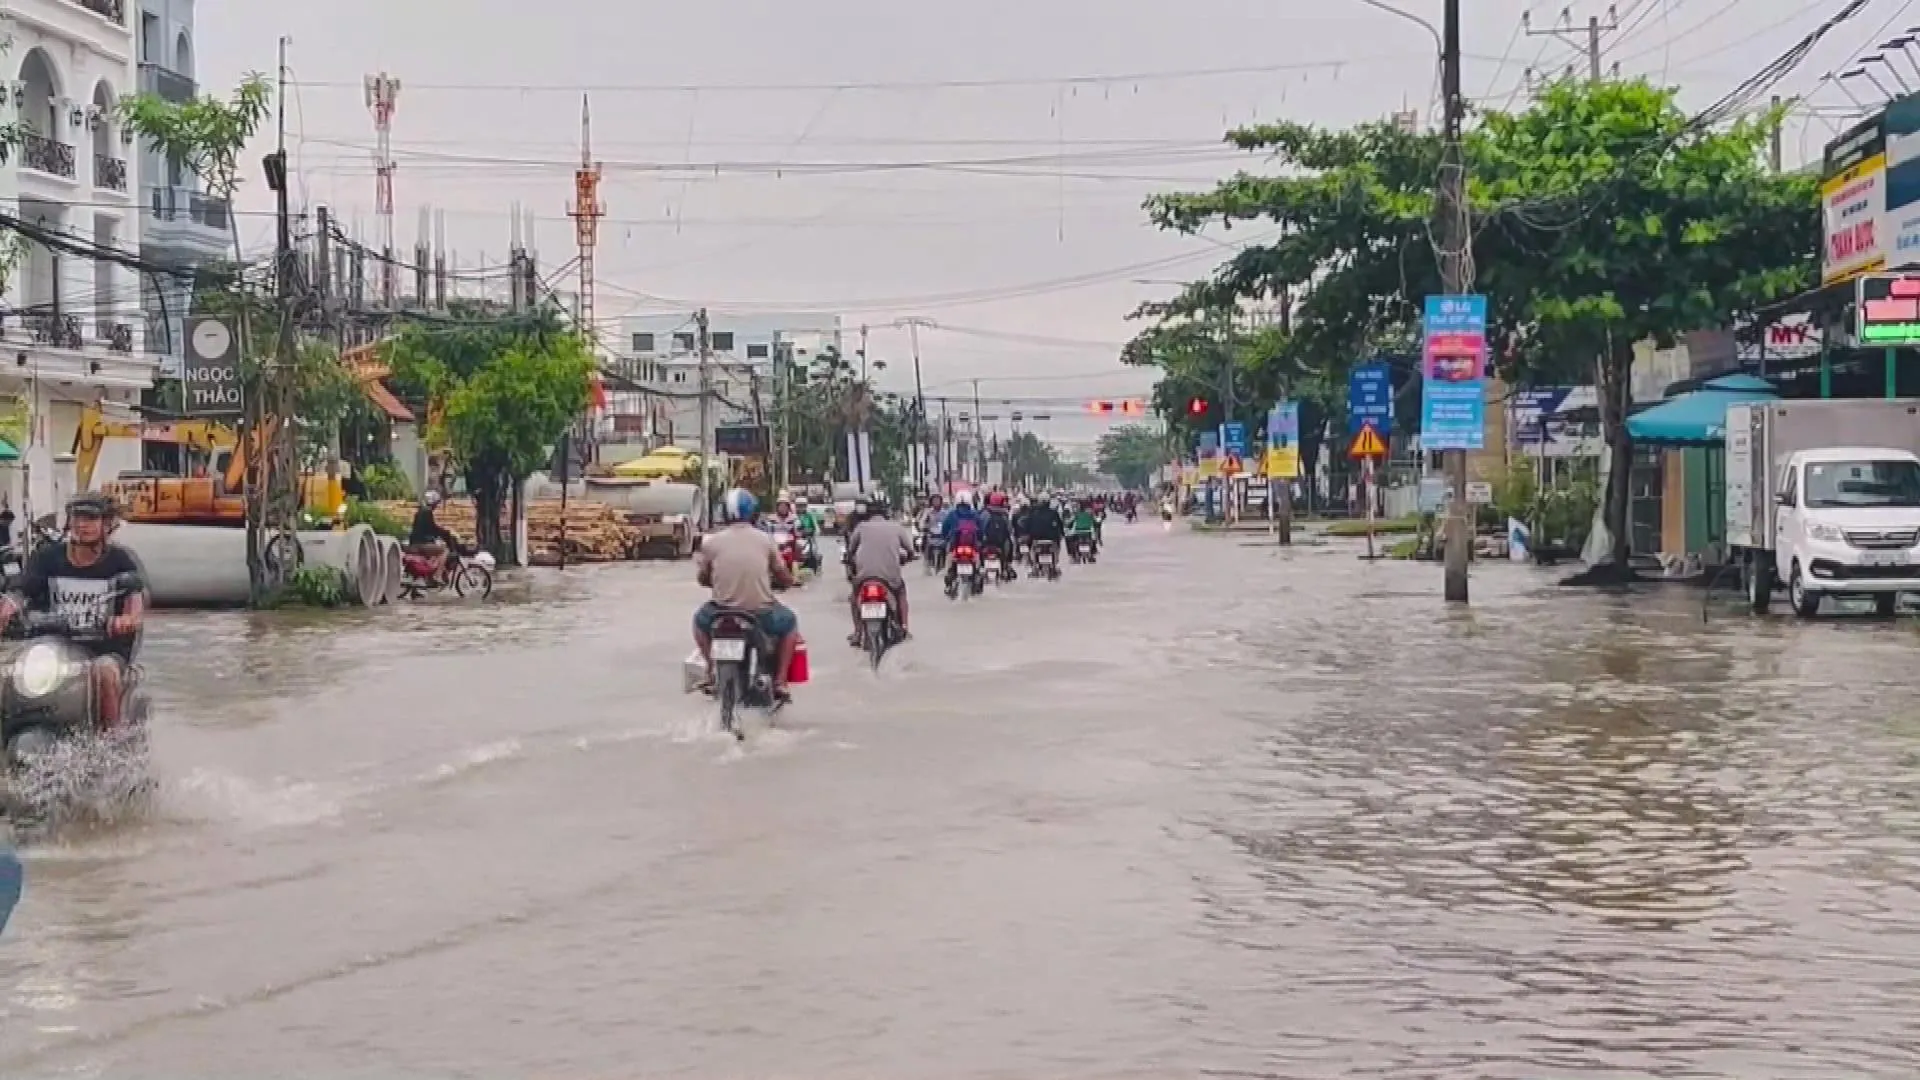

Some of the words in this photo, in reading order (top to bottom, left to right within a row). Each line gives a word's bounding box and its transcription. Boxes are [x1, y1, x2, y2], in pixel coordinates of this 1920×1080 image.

[1455, 301, 1472, 313] LG
[186, 367, 234, 384] NGỌC
[192, 384, 240, 404] THẢO
